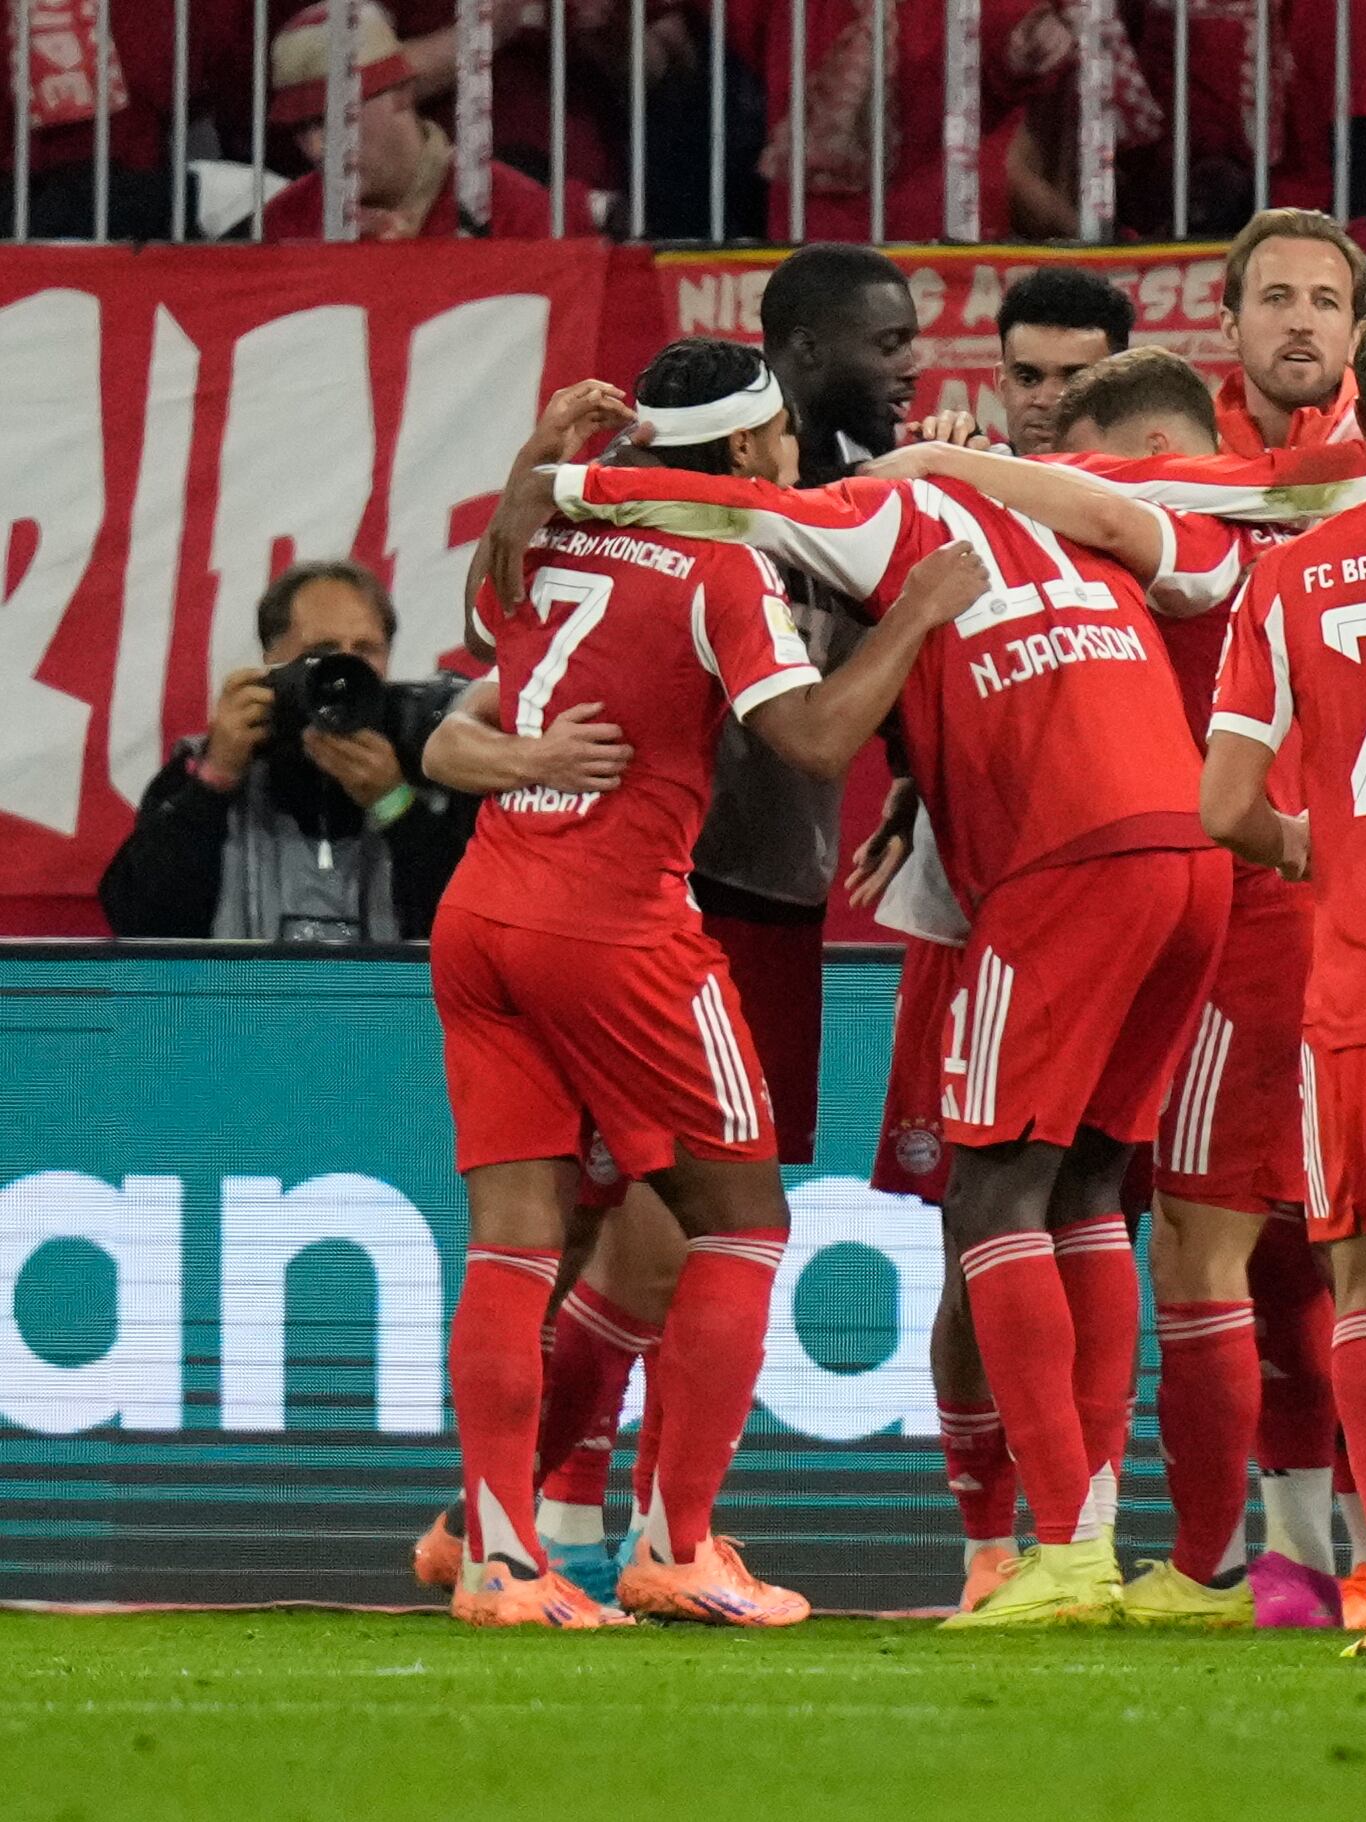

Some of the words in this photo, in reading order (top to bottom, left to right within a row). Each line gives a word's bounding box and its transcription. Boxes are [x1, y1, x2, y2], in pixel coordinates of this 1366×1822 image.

[594, 534, 696, 580] MÜNCHEN
[1304, 563, 1334, 593] FC
[516, 565, 614, 740] 7
[970, 623, 1148, 699] N.JACKSON
